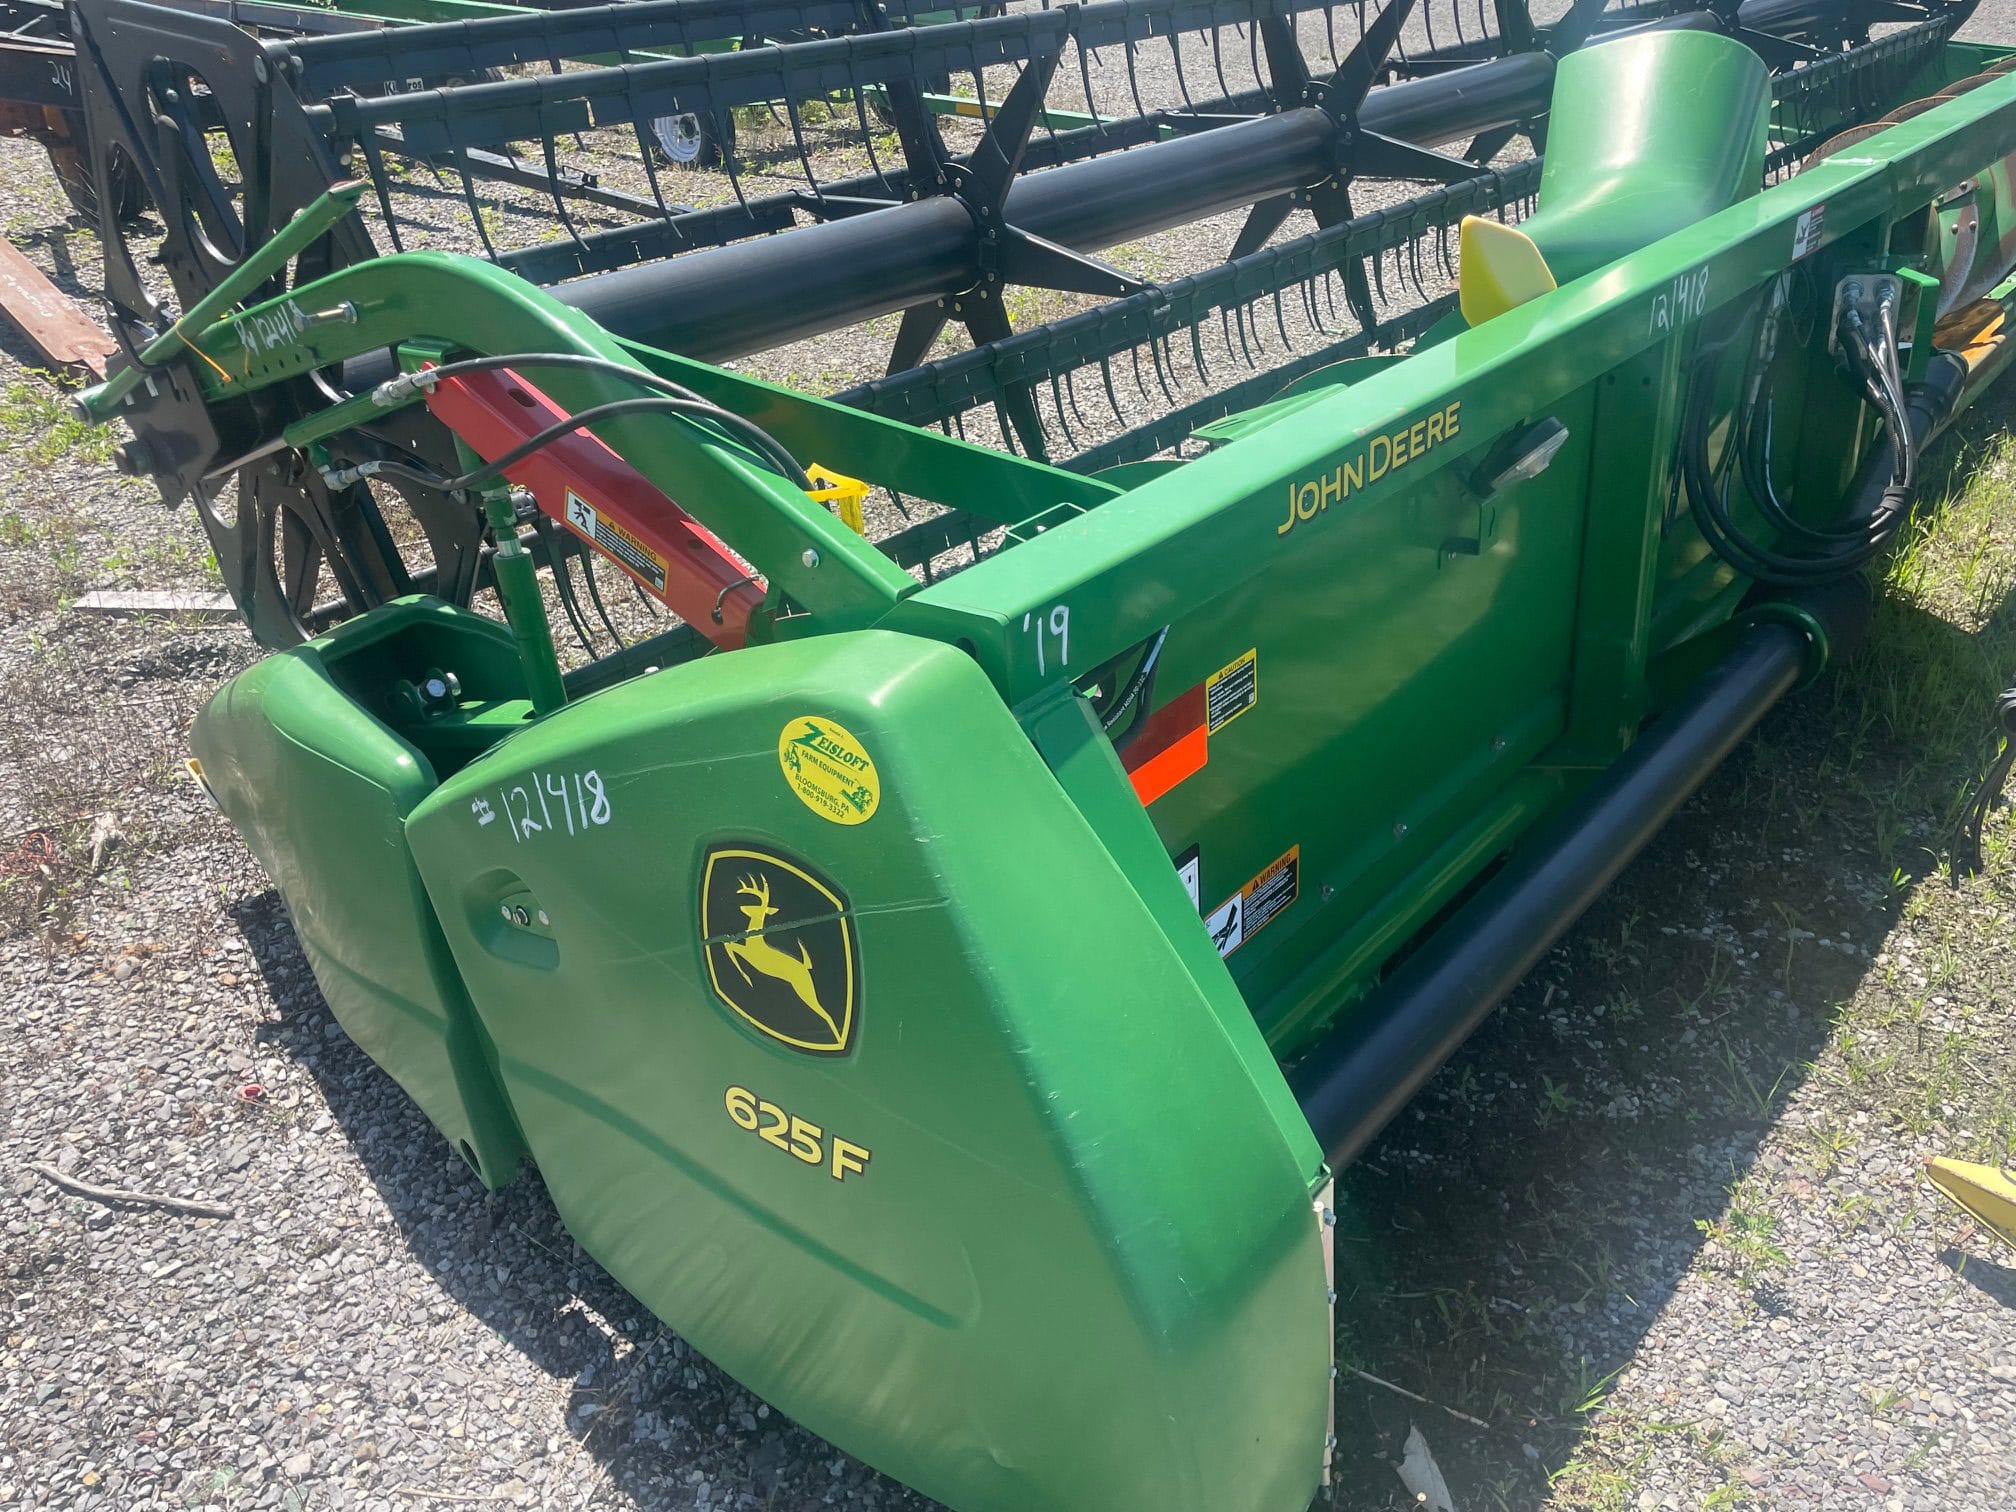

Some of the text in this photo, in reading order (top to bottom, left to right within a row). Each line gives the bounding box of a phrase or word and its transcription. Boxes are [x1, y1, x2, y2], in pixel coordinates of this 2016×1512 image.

[1648, 264, 1706, 336] 121418
[1277, 400, 1462, 537] JOHN DEERE
[617, 527, 657, 562] WARNING
[1223, 657, 1246, 677] CAUTION
[789, 721, 870, 772] ZEISLOFT
[801, 750, 855, 788] FARM EQUIPMENT
[500, 769, 611, 844] 121418
[1259, 852, 1291, 884] WARNING
[725, 1085, 871, 1181] 625 F
